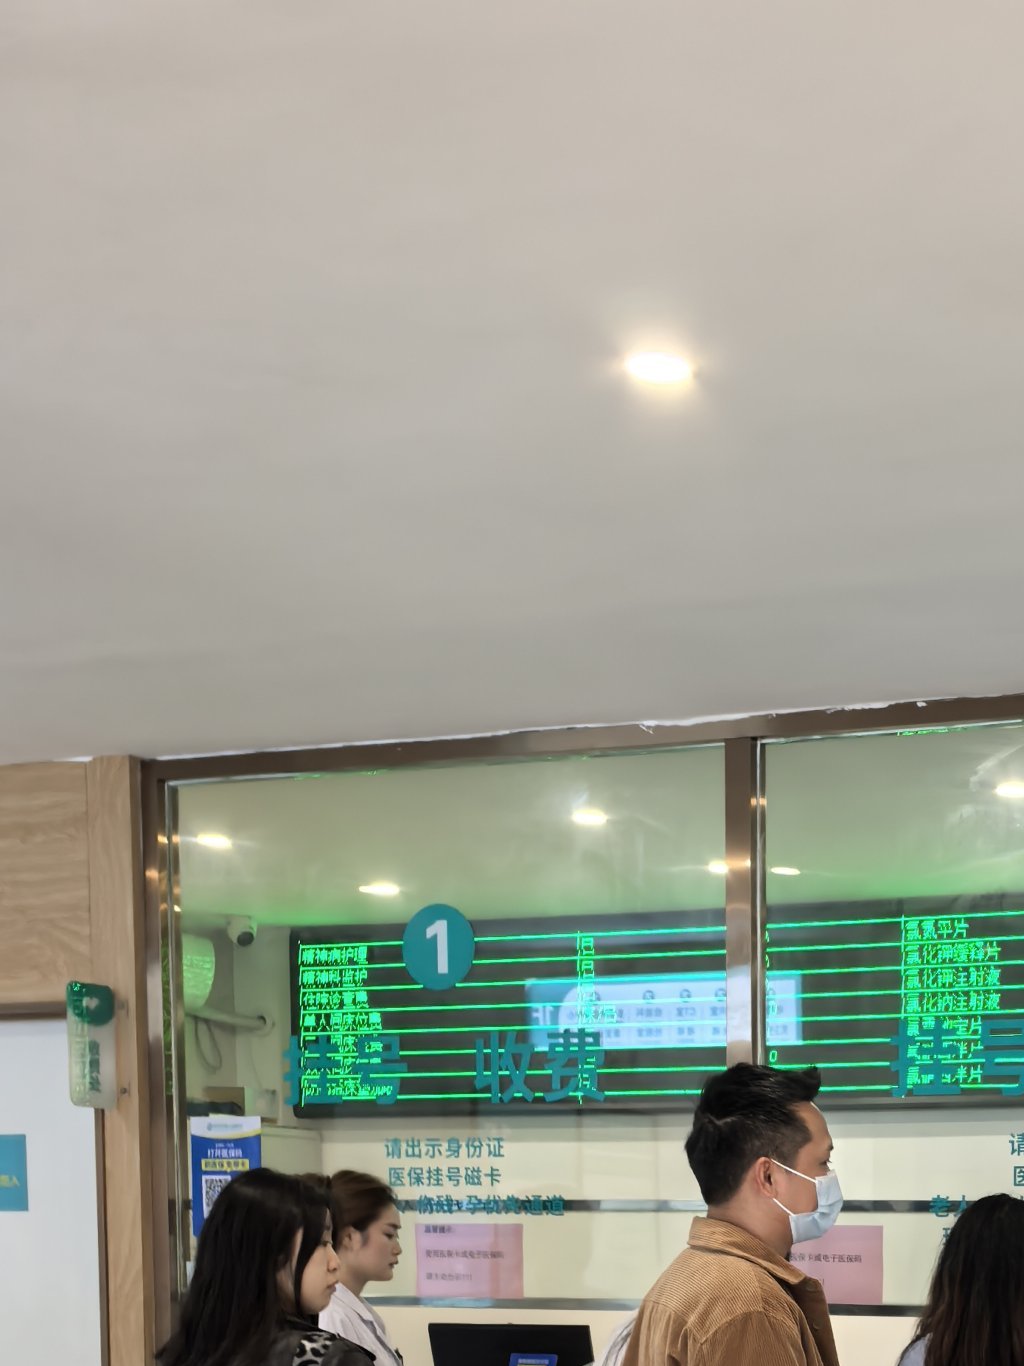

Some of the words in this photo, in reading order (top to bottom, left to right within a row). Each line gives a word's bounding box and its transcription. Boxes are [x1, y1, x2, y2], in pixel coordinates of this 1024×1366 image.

[425, 919, 449, 975] 1
[475, 1027, 605, 1103] 收费
[384, 1136, 505, 1160] 请出示身份证
[388, 1166, 502, 1187] 医保挂号磁卡
